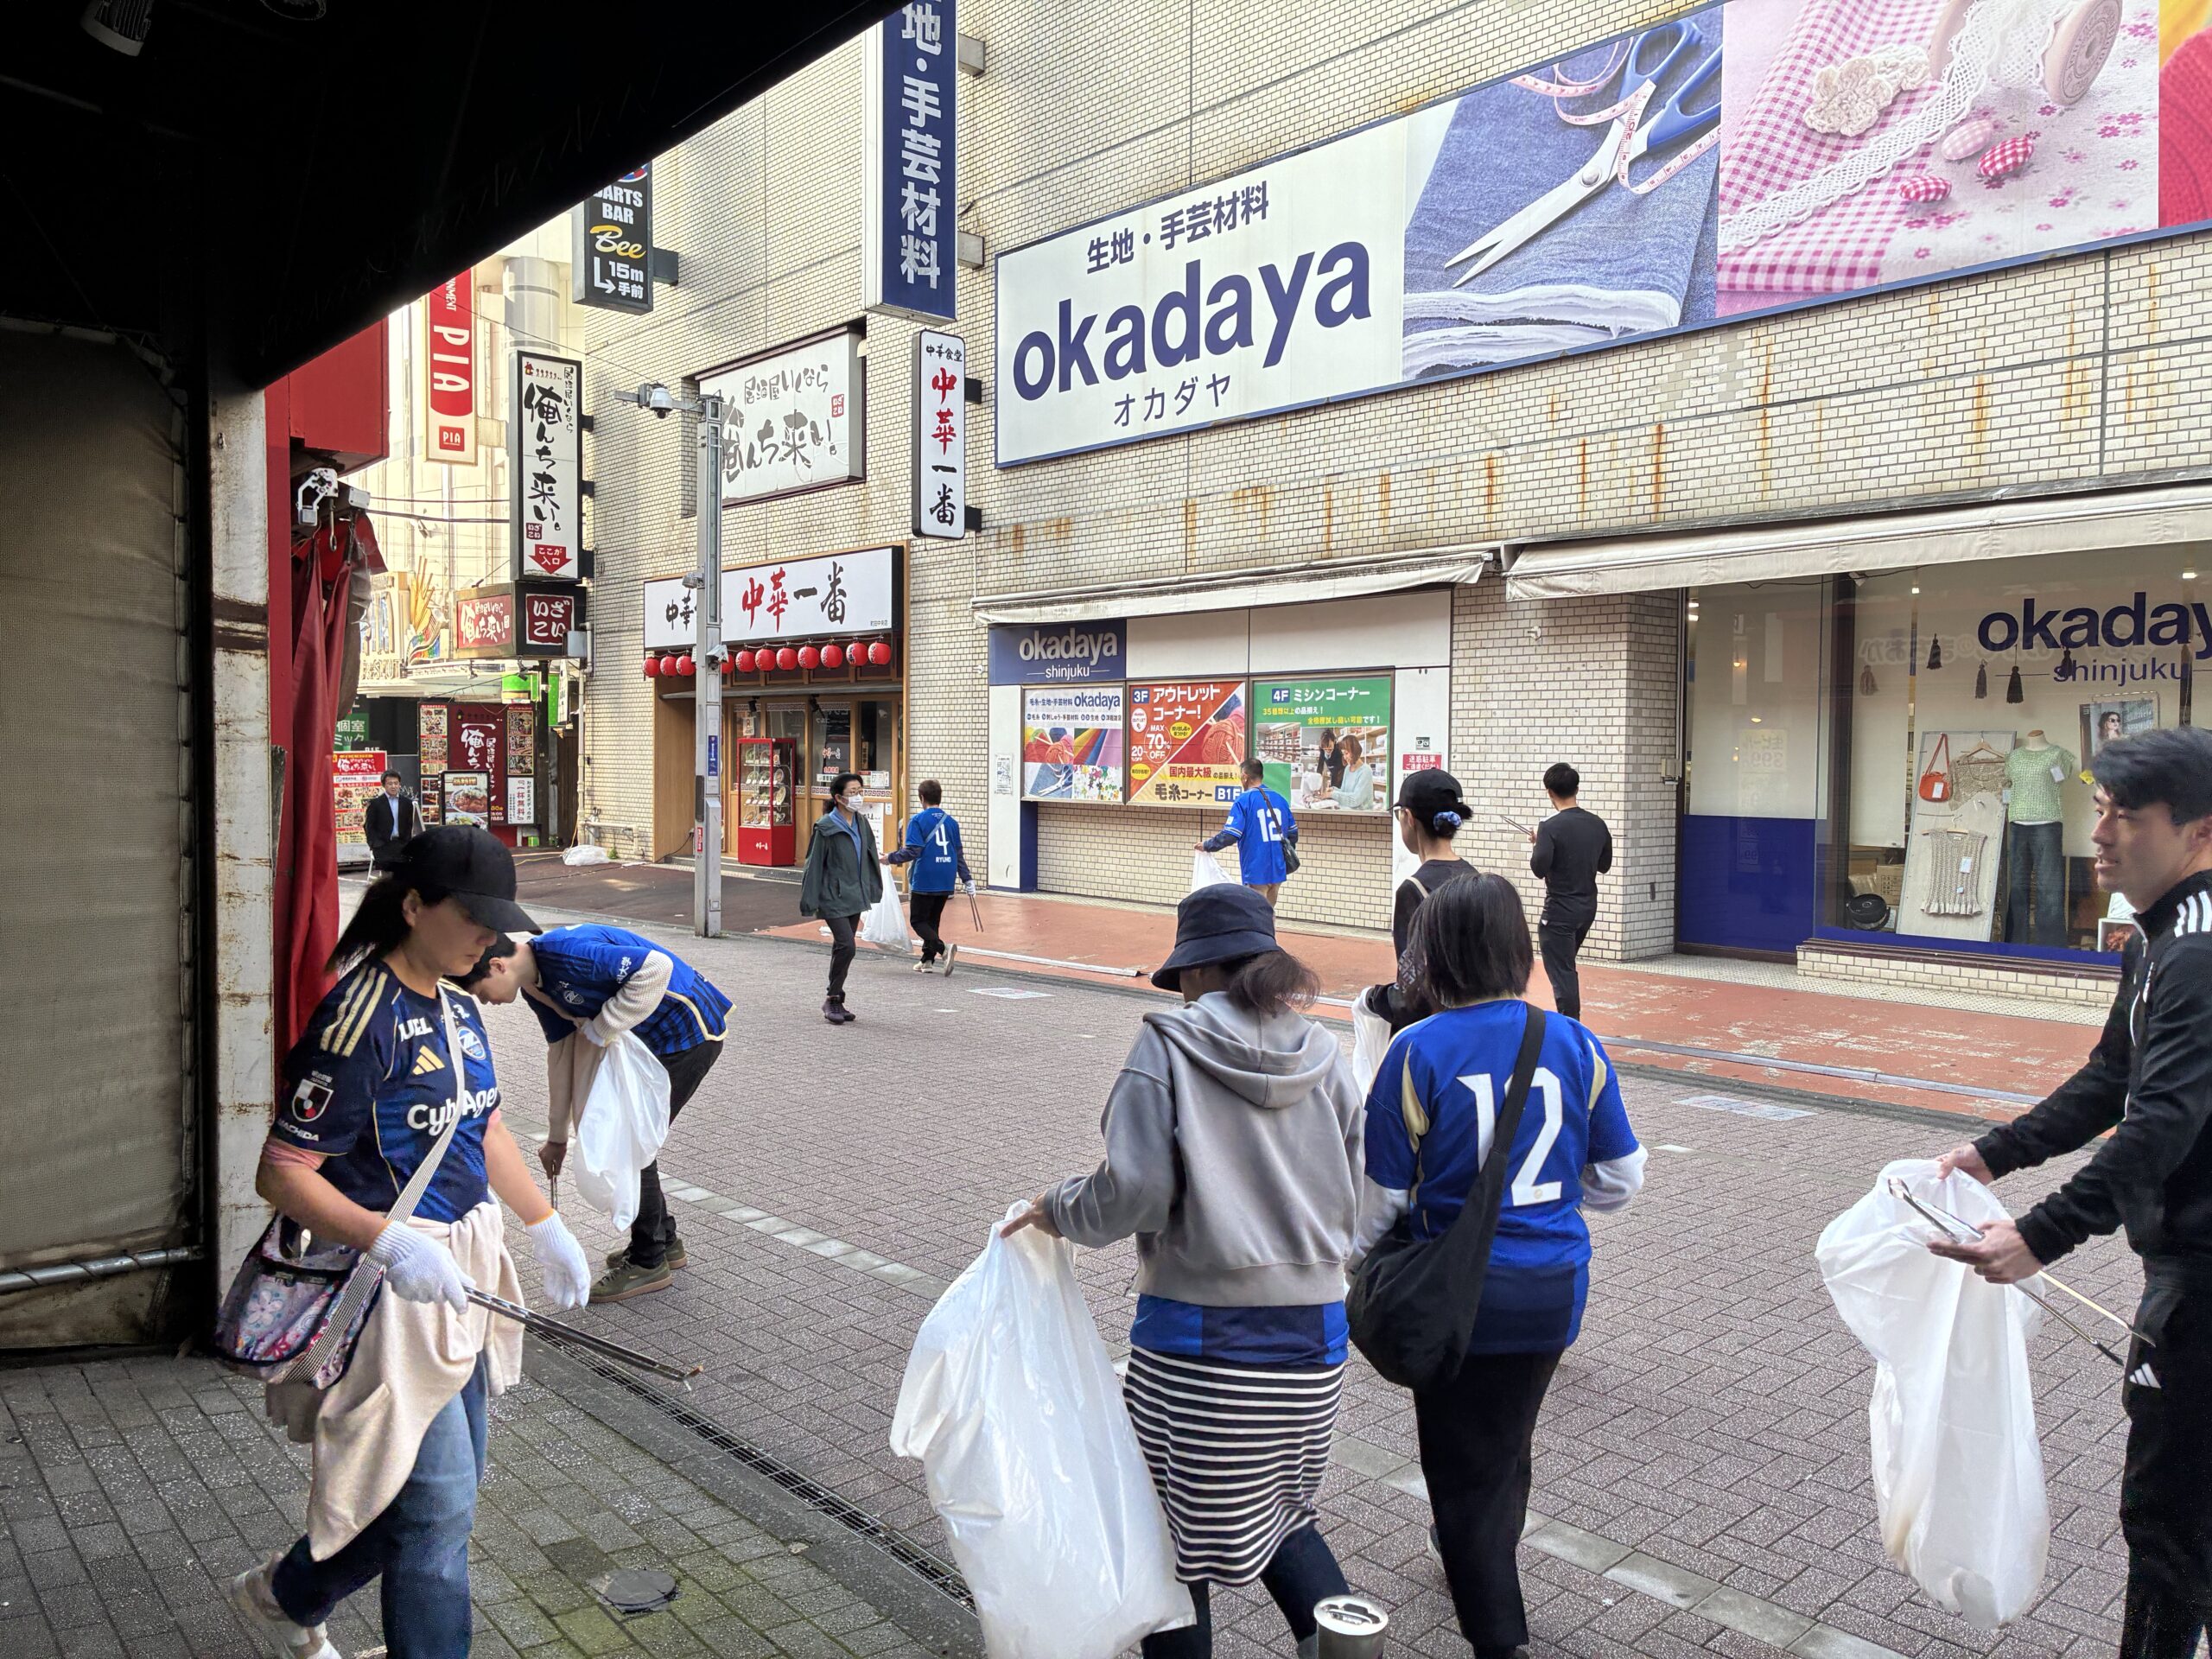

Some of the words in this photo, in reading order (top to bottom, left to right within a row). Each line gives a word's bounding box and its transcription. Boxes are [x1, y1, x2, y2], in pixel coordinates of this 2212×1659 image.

[594, 185, 644, 207] ARTS
[602, 203, 634, 225] BAR
[1087, 181, 1268, 274] 生地・手芸材料
[590, 225, 646, 258] Bee
[609, 261, 644, 283] 15m
[619, 282, 644, 299] 手前
[1013, 241, 1371, 401] okadaya
[434, 325, 470, 392] PIA
[926, 344, 963, 362] 中華食堂
[1114, 373, 1230, 427] オカダヤ
[443, 431, 461, 442] PIA
[930, 367, 957, 527] 中華一番
[741, 561, 847, 633] 中華一番
[533, 600, 570, 618] いざ
[665, 589, 697, 631] 中華
[1020, 627, 1117, 666] okadaya
[1046, 664, 1090, 681] shinjuku
[1074, 692, 1121, 710] okadaya
[1134, 691, 1148, 702] 3F
[1153, 683, 1221, 703] アウトレット
[1273, 690, 1289, 702] 4F
[1294, 686, 1370, 702] ミシンコーナー
[1149, 751, 1166, 760] OFF
[1169, 766, 1211, 778] 国内最大級
[1154, 783, 1213, 801] 毛糸コーナー
[1217, 788, 1241, 799] B1F
[1257, 808, 1283, 842] 12
[935, 823, 950, 855] 4
[1457, 1066, 1563, 1207] 12
